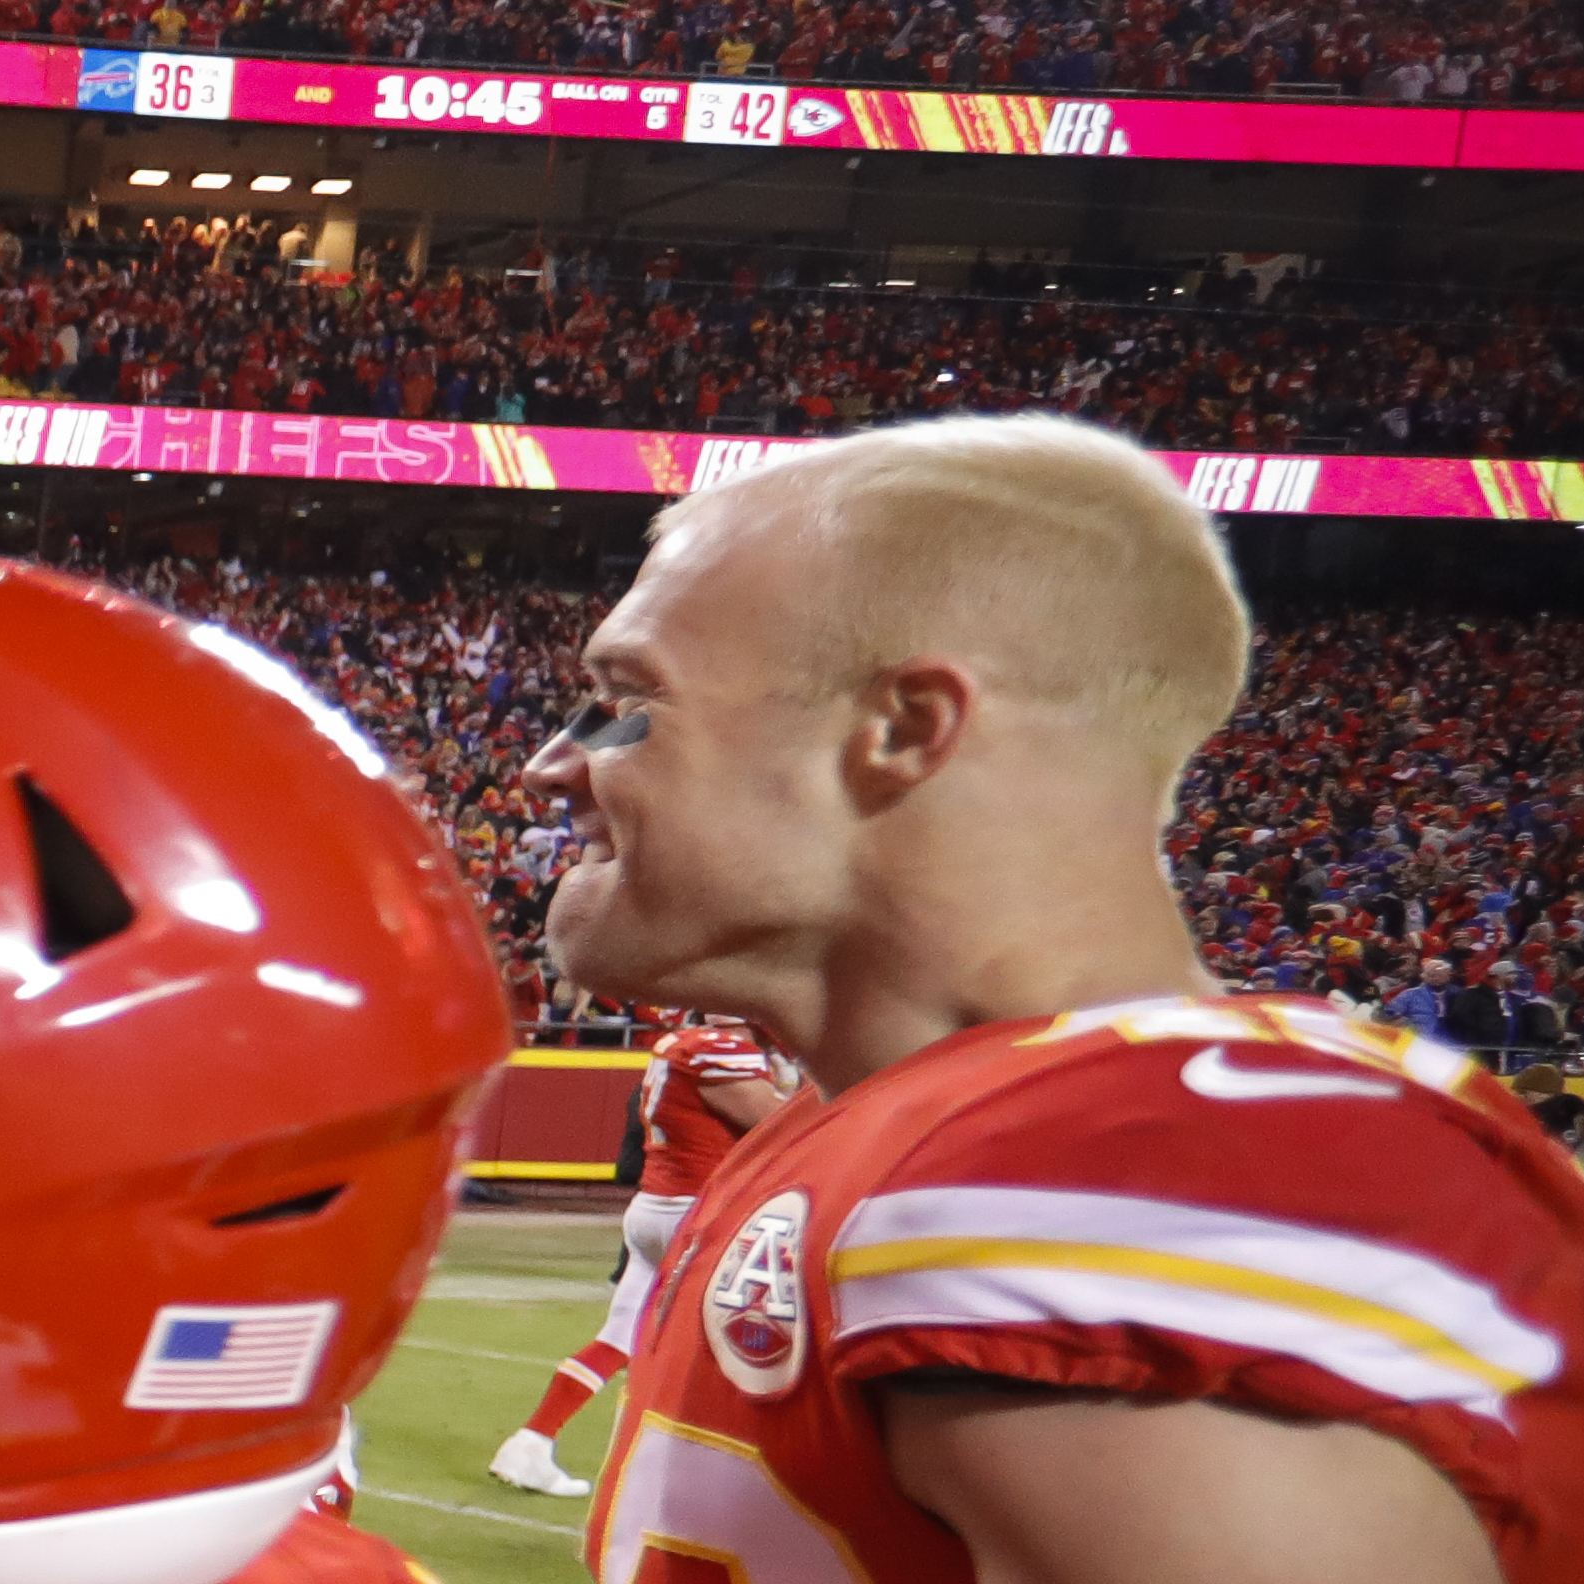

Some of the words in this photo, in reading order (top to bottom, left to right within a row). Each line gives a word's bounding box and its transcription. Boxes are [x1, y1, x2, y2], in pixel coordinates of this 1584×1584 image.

[150, 63, 194, 111] 36
[200, 85, 216, 104] 3
[295, 86, 332, 104] AND
[374, 75, 542, 126] 10:45
[551, 82, 598, 101] BALL
[699, 110, 716, 129] 3
[730, 92, 776, 139] 42
[714, 1214, 797, 1321] A
